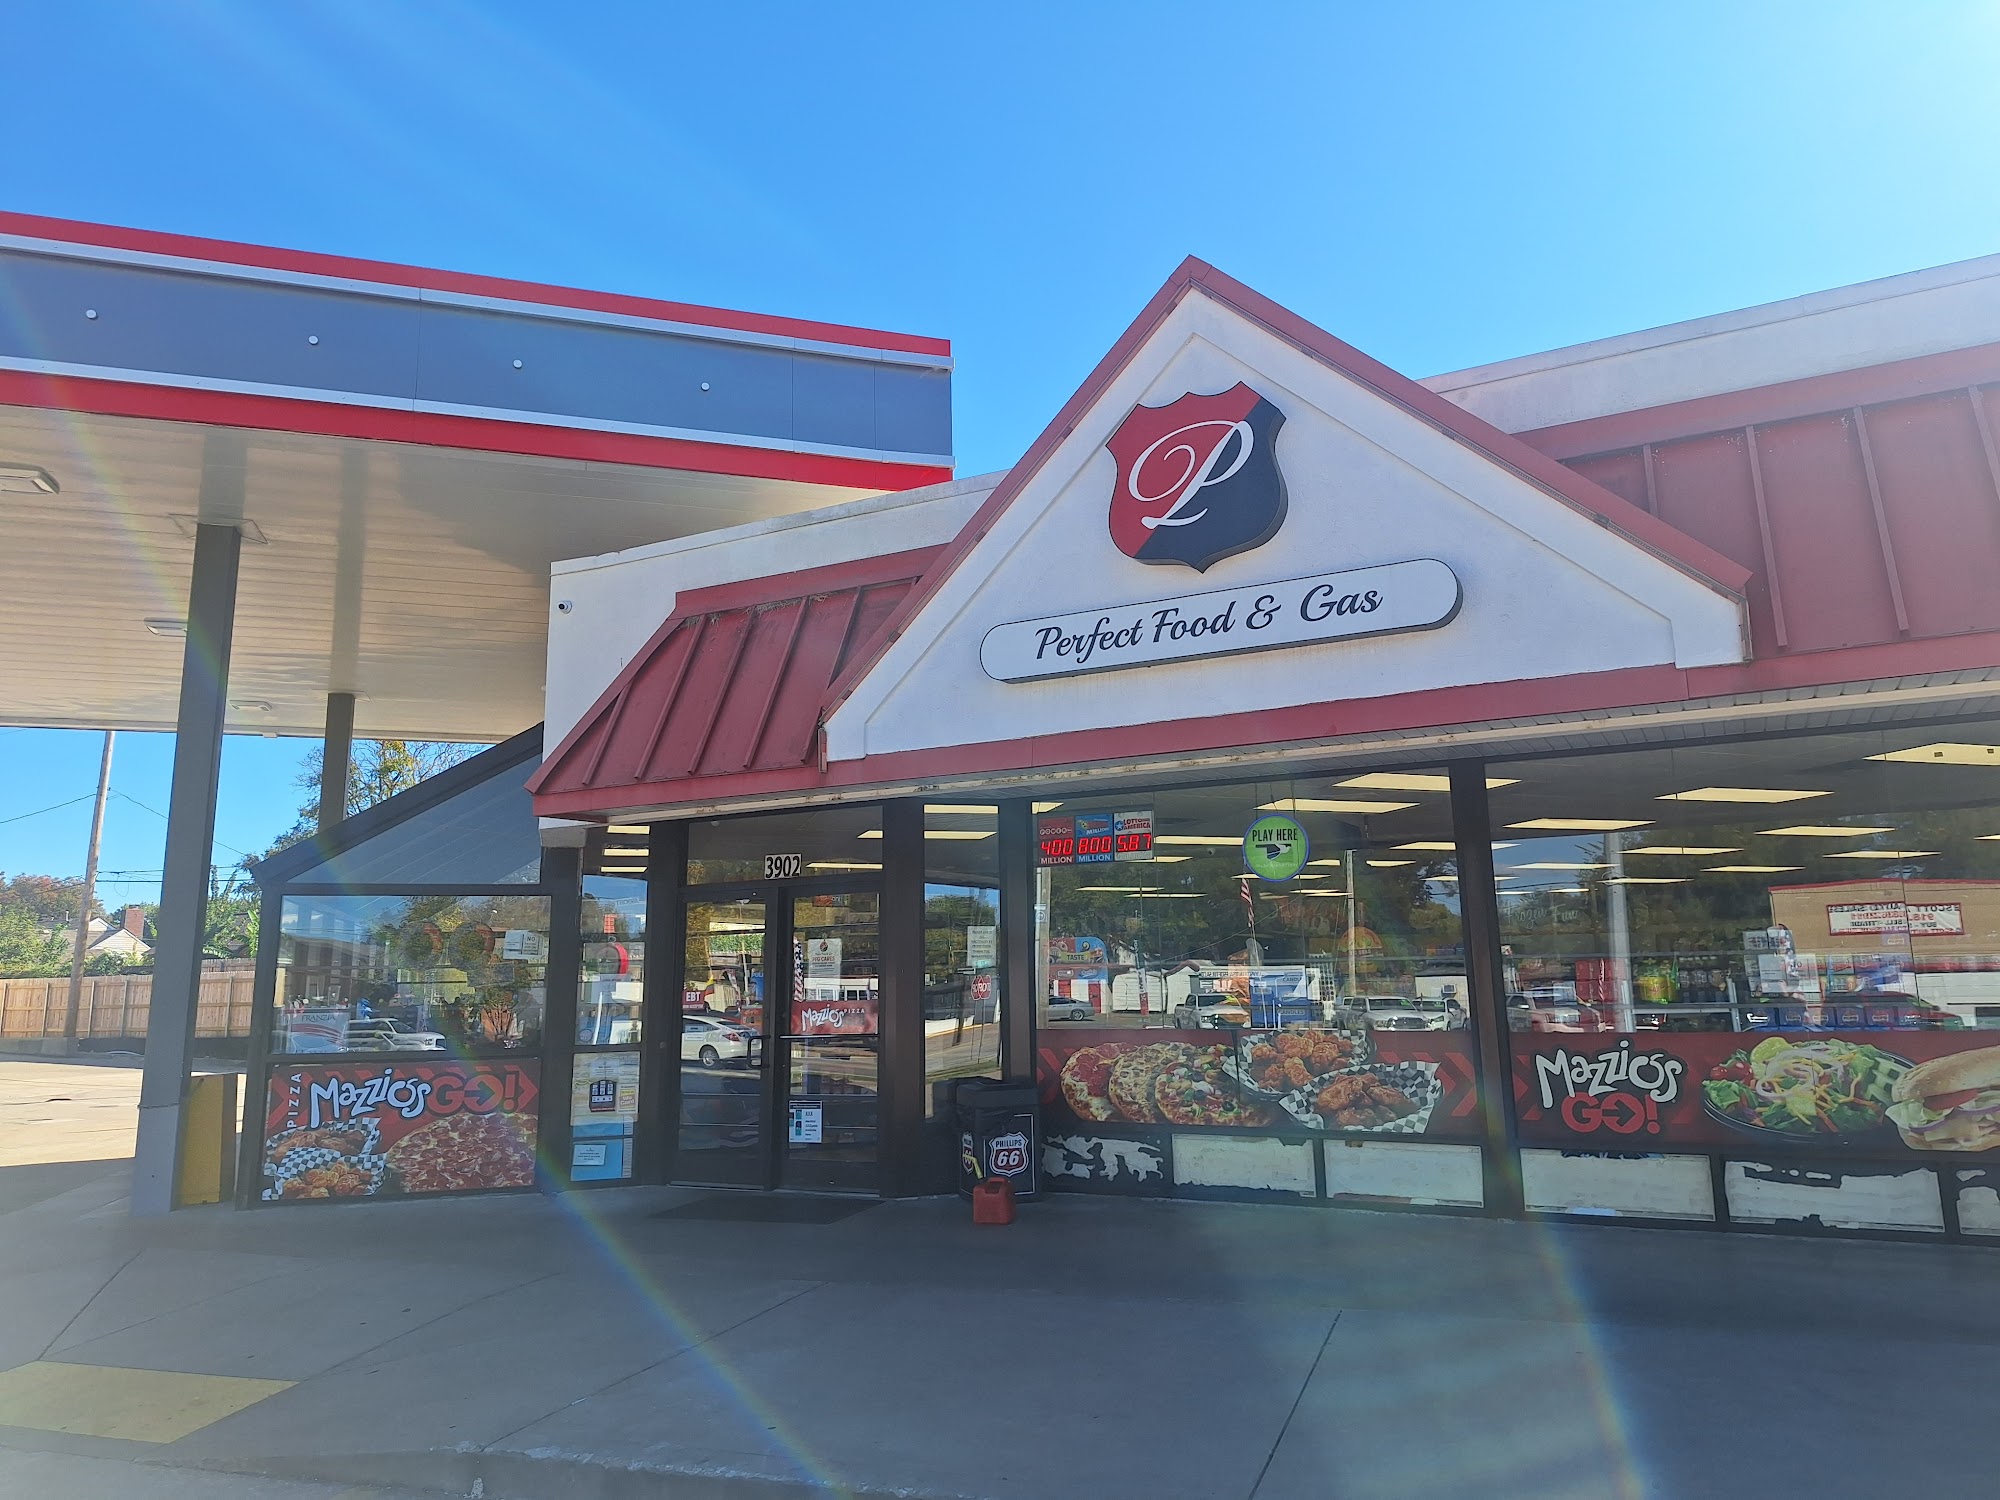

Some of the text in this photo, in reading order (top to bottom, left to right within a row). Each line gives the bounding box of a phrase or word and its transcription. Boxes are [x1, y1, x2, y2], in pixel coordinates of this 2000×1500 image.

[1035, 583, 1384, 664] Perfect Food & Gas
[1123, 822, 1151, 830] AMERICA
[1252, 828, 1298, 842] PLAY HERE
[1041, 839, 1074, 856] 400
[1078, 836, 1112, 854] 800
[1041, 857, 1072, 865] MILLION
[1078, 854, 1111, 863] MILLION
[765, 855, 800, 879] 3902
[686, 991, 701, 1002] EBT
[286, 1072, 302, 1128] PIZZA
[995, 1139, 1023, 1148] PHILLIPS
[997, 1150, 1021, 1167] 66
